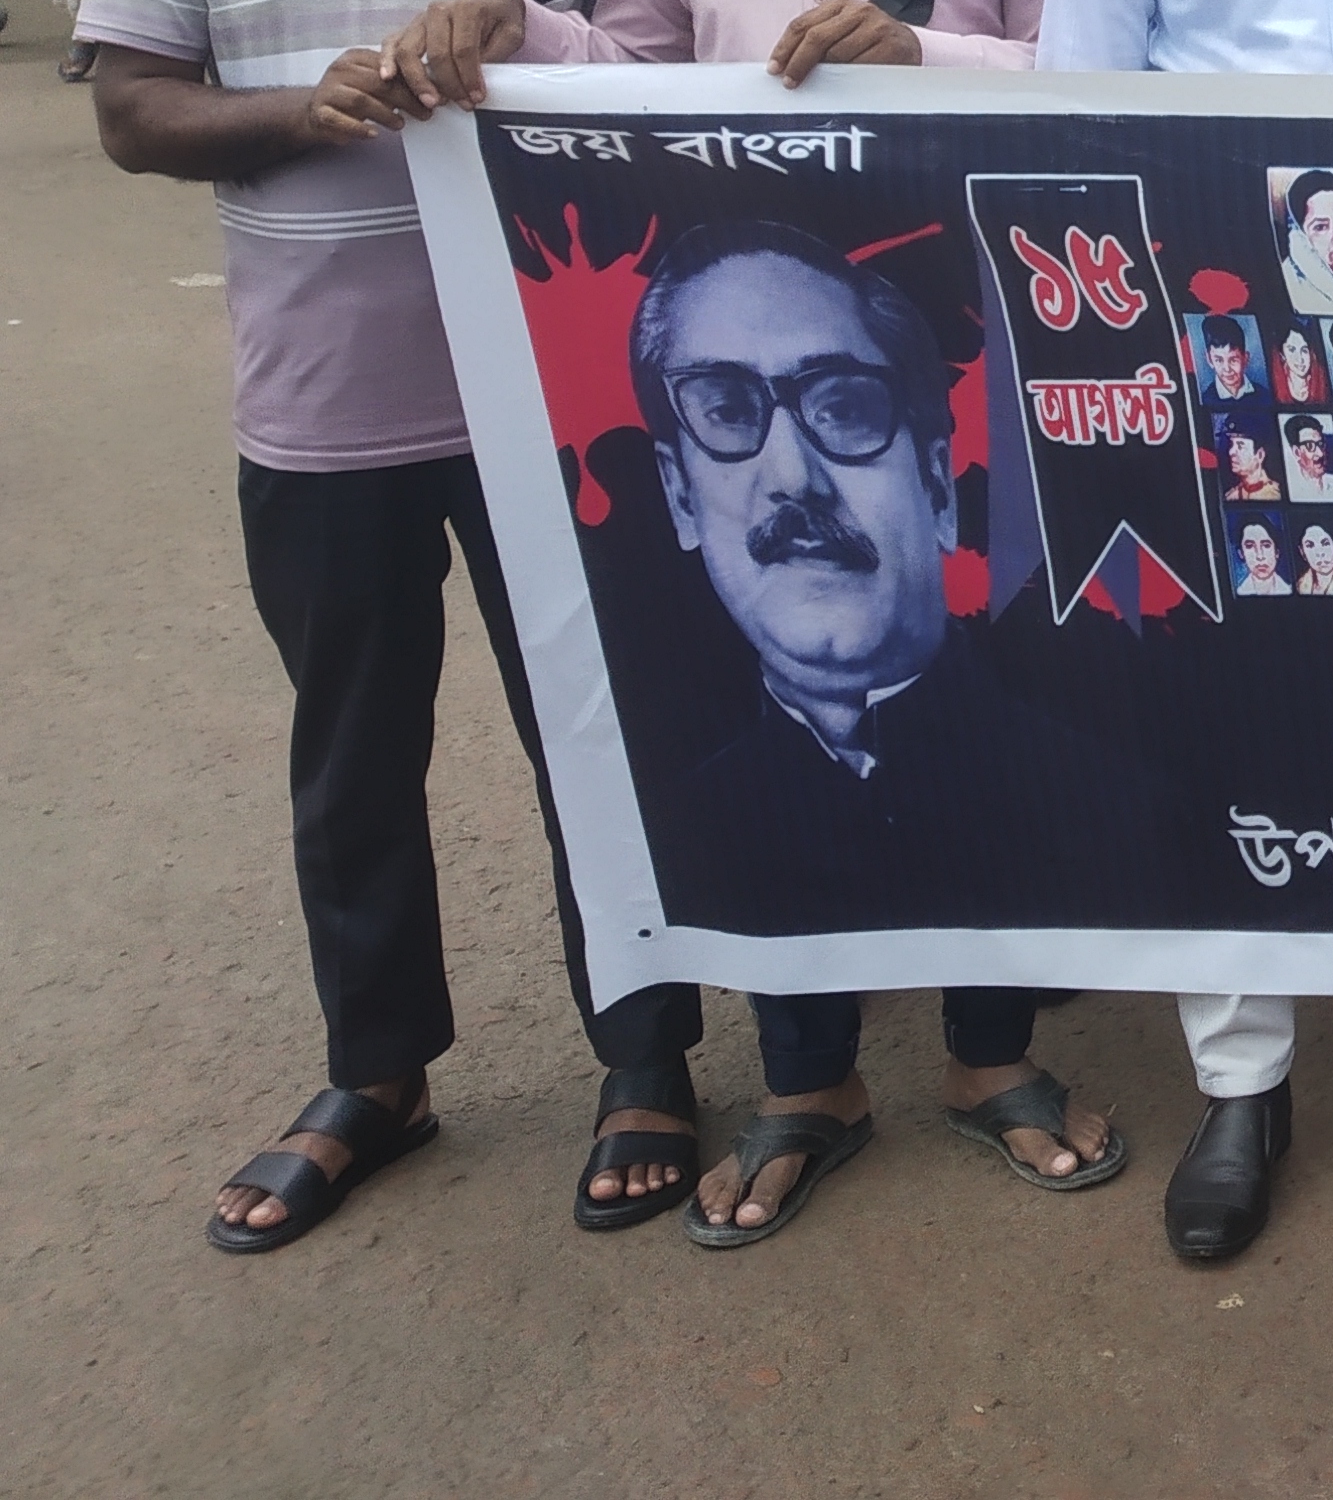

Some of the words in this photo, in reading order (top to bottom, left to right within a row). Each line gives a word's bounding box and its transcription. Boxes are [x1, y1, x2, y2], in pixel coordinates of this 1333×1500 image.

[500, 124, 634, 163] জয়
[651, 124, 878, 175] বাংলা
[1008, 225, 1148, 332] ১৫
[1025, 362, 1178, 446] আগস্ট
